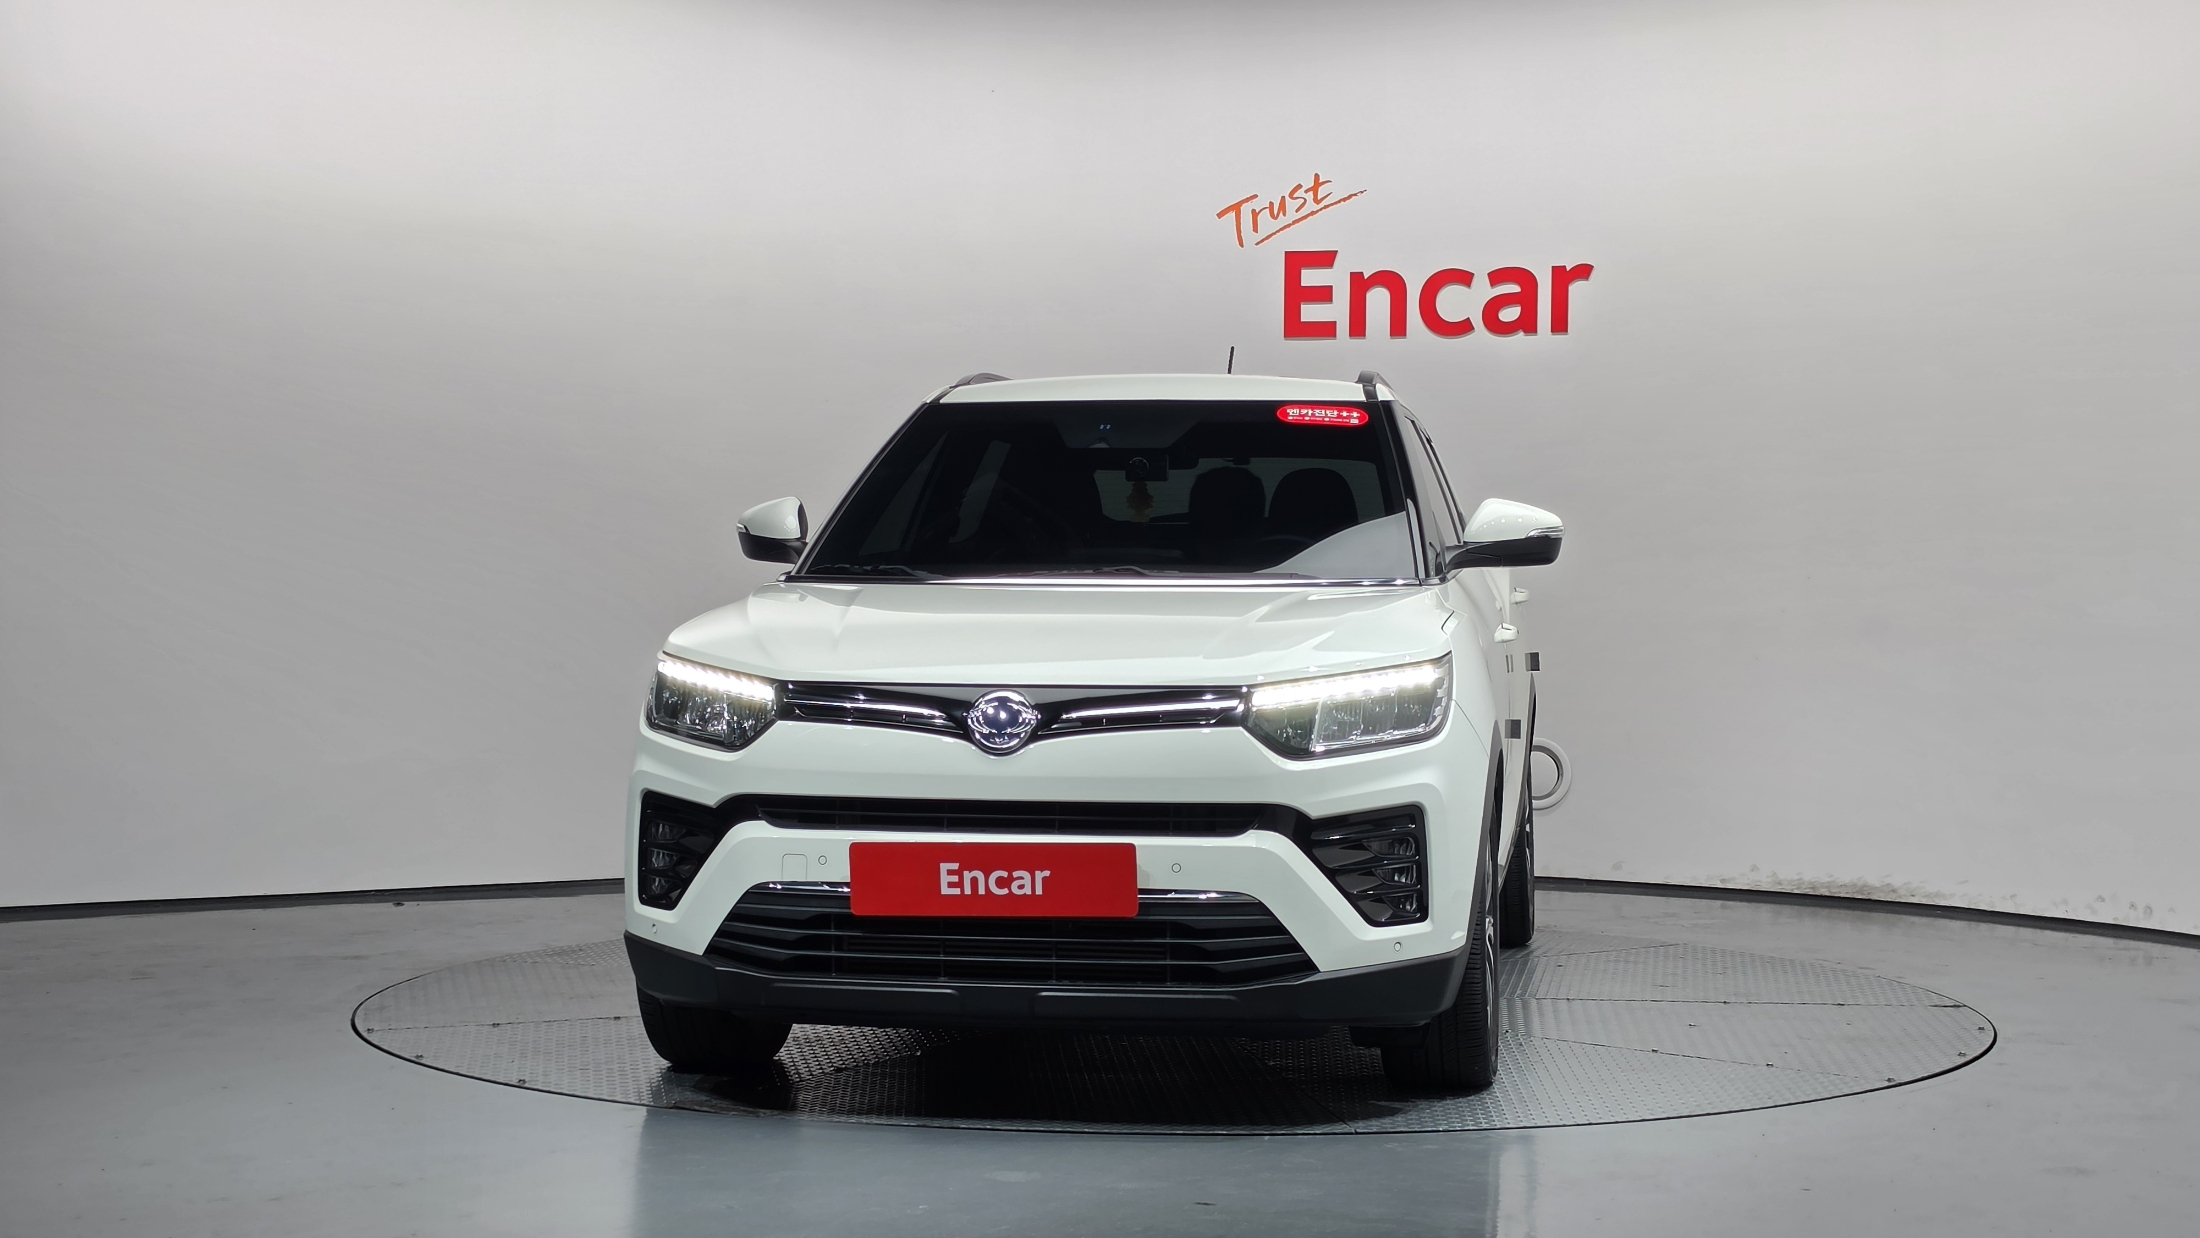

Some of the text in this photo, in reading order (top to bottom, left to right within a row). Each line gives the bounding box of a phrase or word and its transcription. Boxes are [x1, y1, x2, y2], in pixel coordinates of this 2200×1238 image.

[1217, 173, 1333, 248] Trust
[1283, 250, 1594, 340] Encar
[939, 862, 1051, 896] Encar
